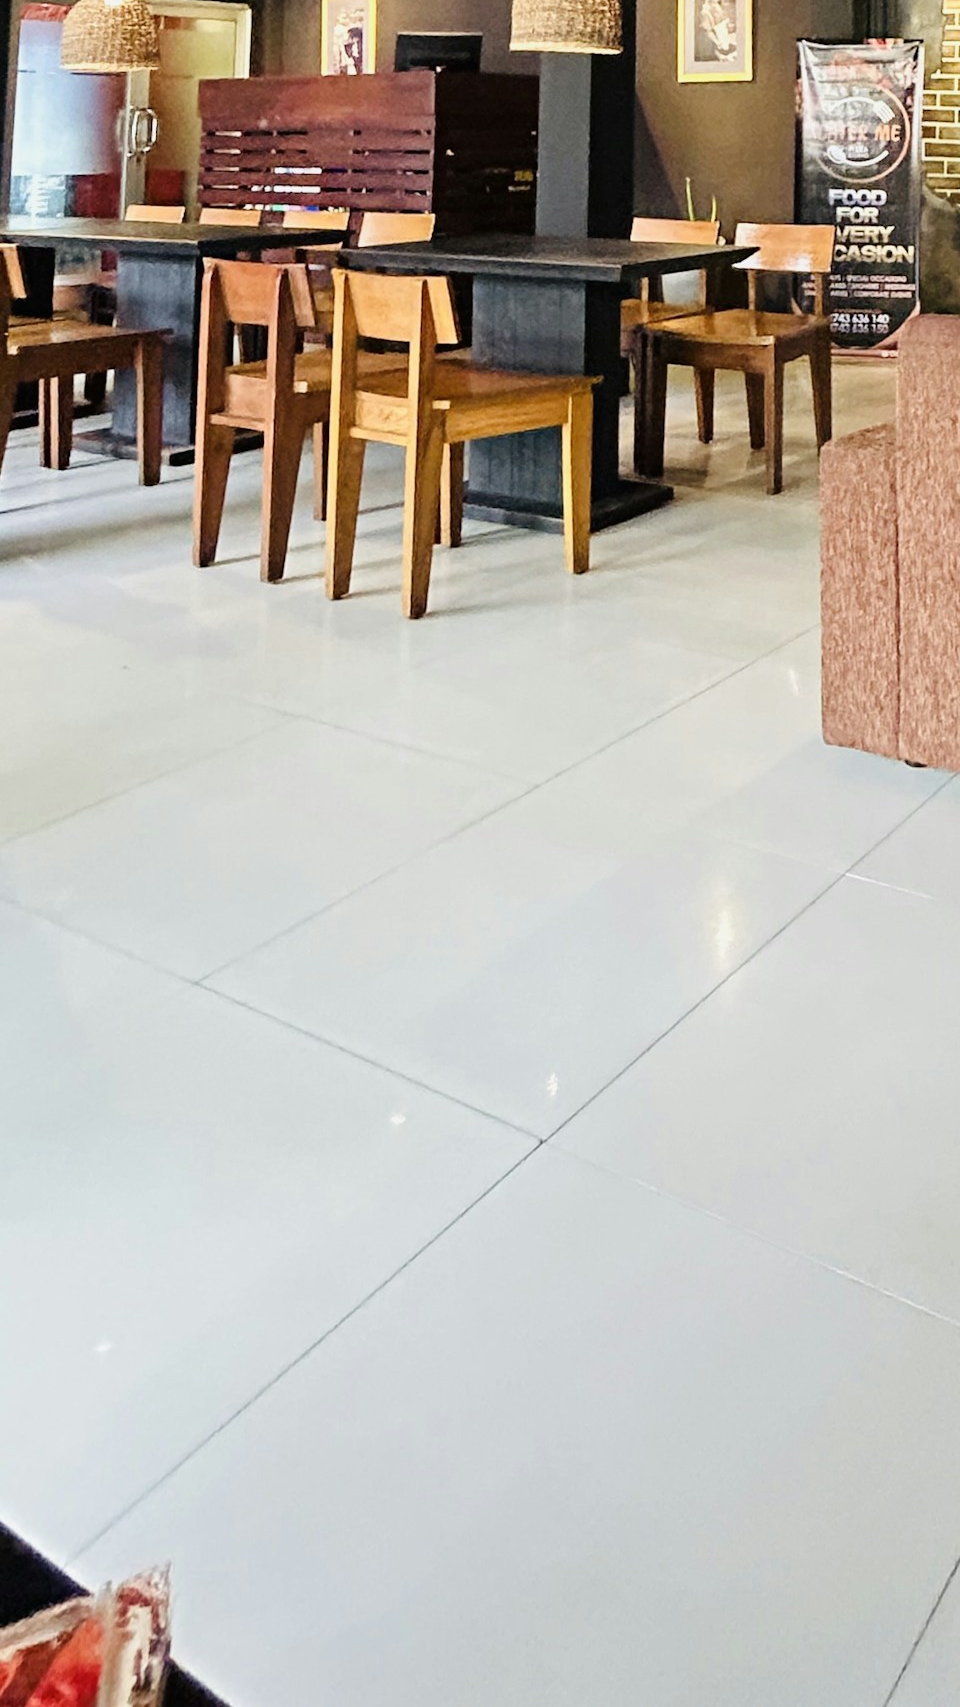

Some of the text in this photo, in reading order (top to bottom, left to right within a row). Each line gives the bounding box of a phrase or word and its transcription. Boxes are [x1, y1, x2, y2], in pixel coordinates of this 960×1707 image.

[874, 124, 901, 142] ME
[828, 188, 887, 206] FOOD
[836, 206, 879, 223] FOR
[836, 225, 896, 243] VERY
[834, 244, 915, 264] CASION
[831, 313, 890, 324] 743 636 140
